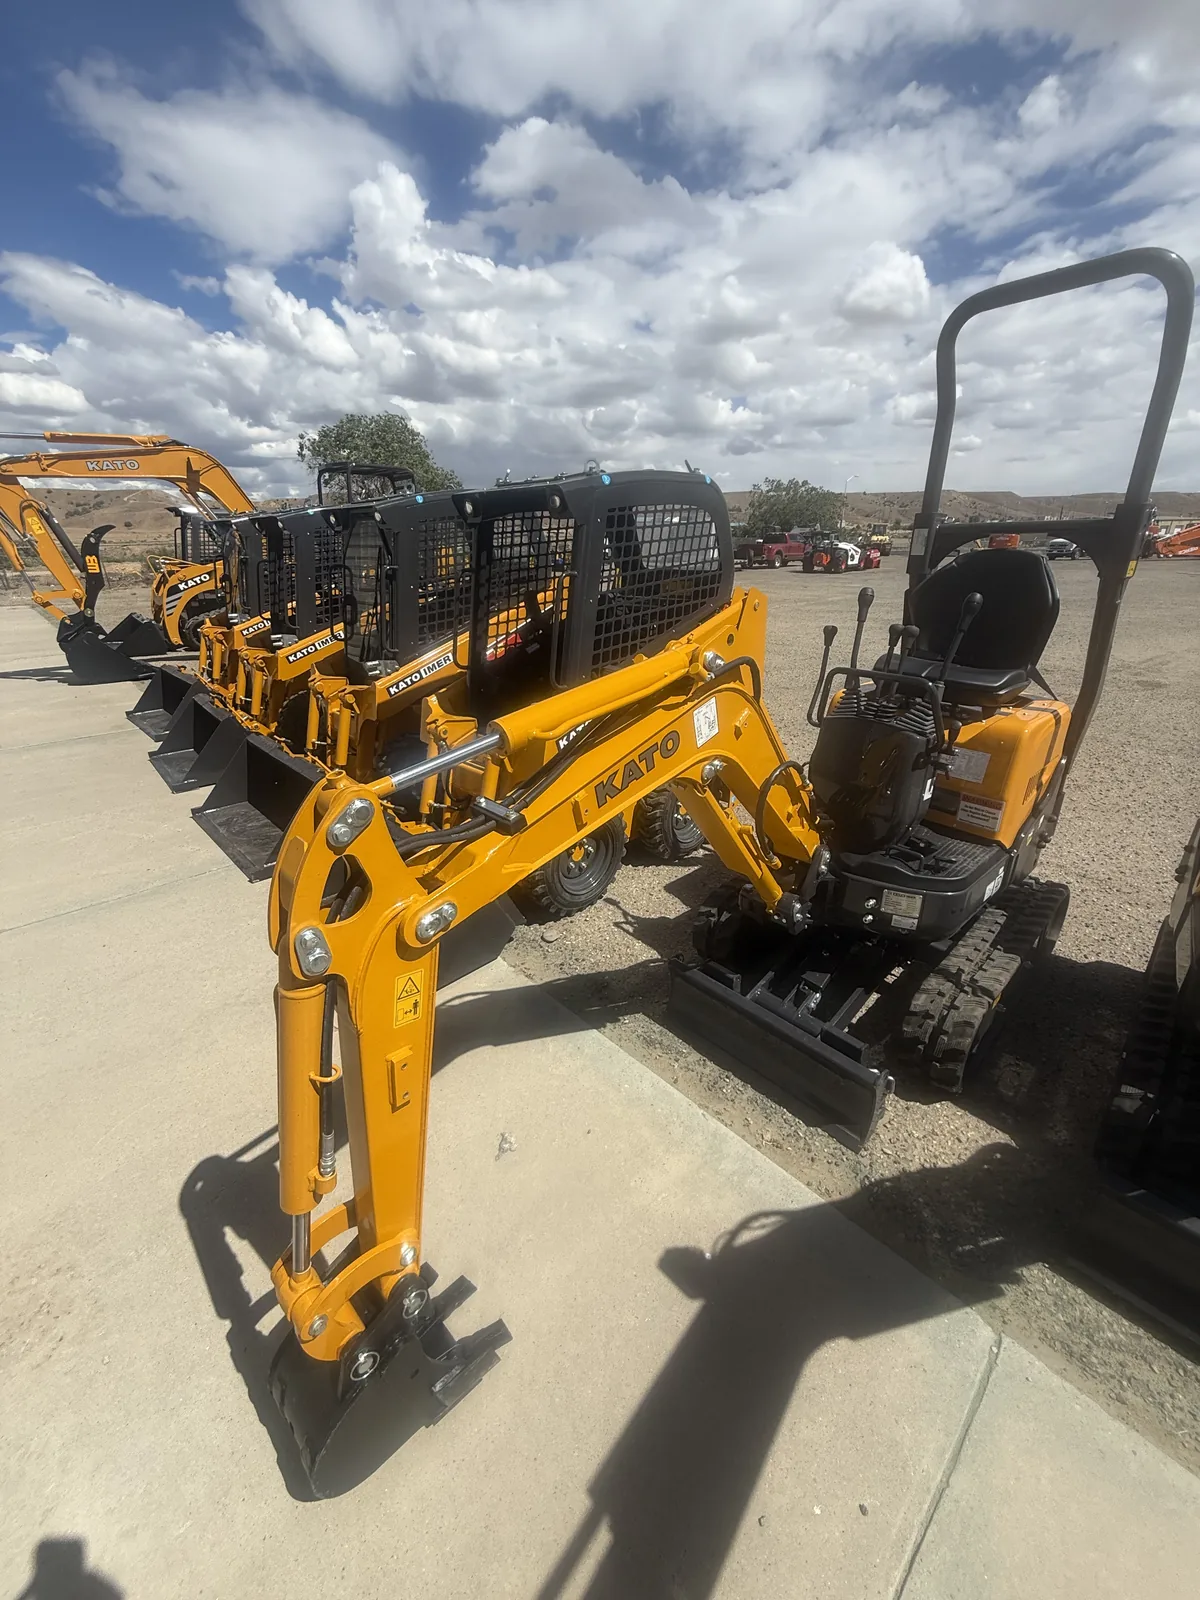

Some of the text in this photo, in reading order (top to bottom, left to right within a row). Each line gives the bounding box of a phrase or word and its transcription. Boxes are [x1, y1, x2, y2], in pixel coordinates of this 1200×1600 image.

[85, 459, 139, 471] KATO
[178, 573, 210, 591] KATO
[242, 622, 264, 636] KATO
[288, 646, 315, 662] KATO
[389, 655, 452, 695] KATO IMER
[594, 729, 681, 809] KATO
